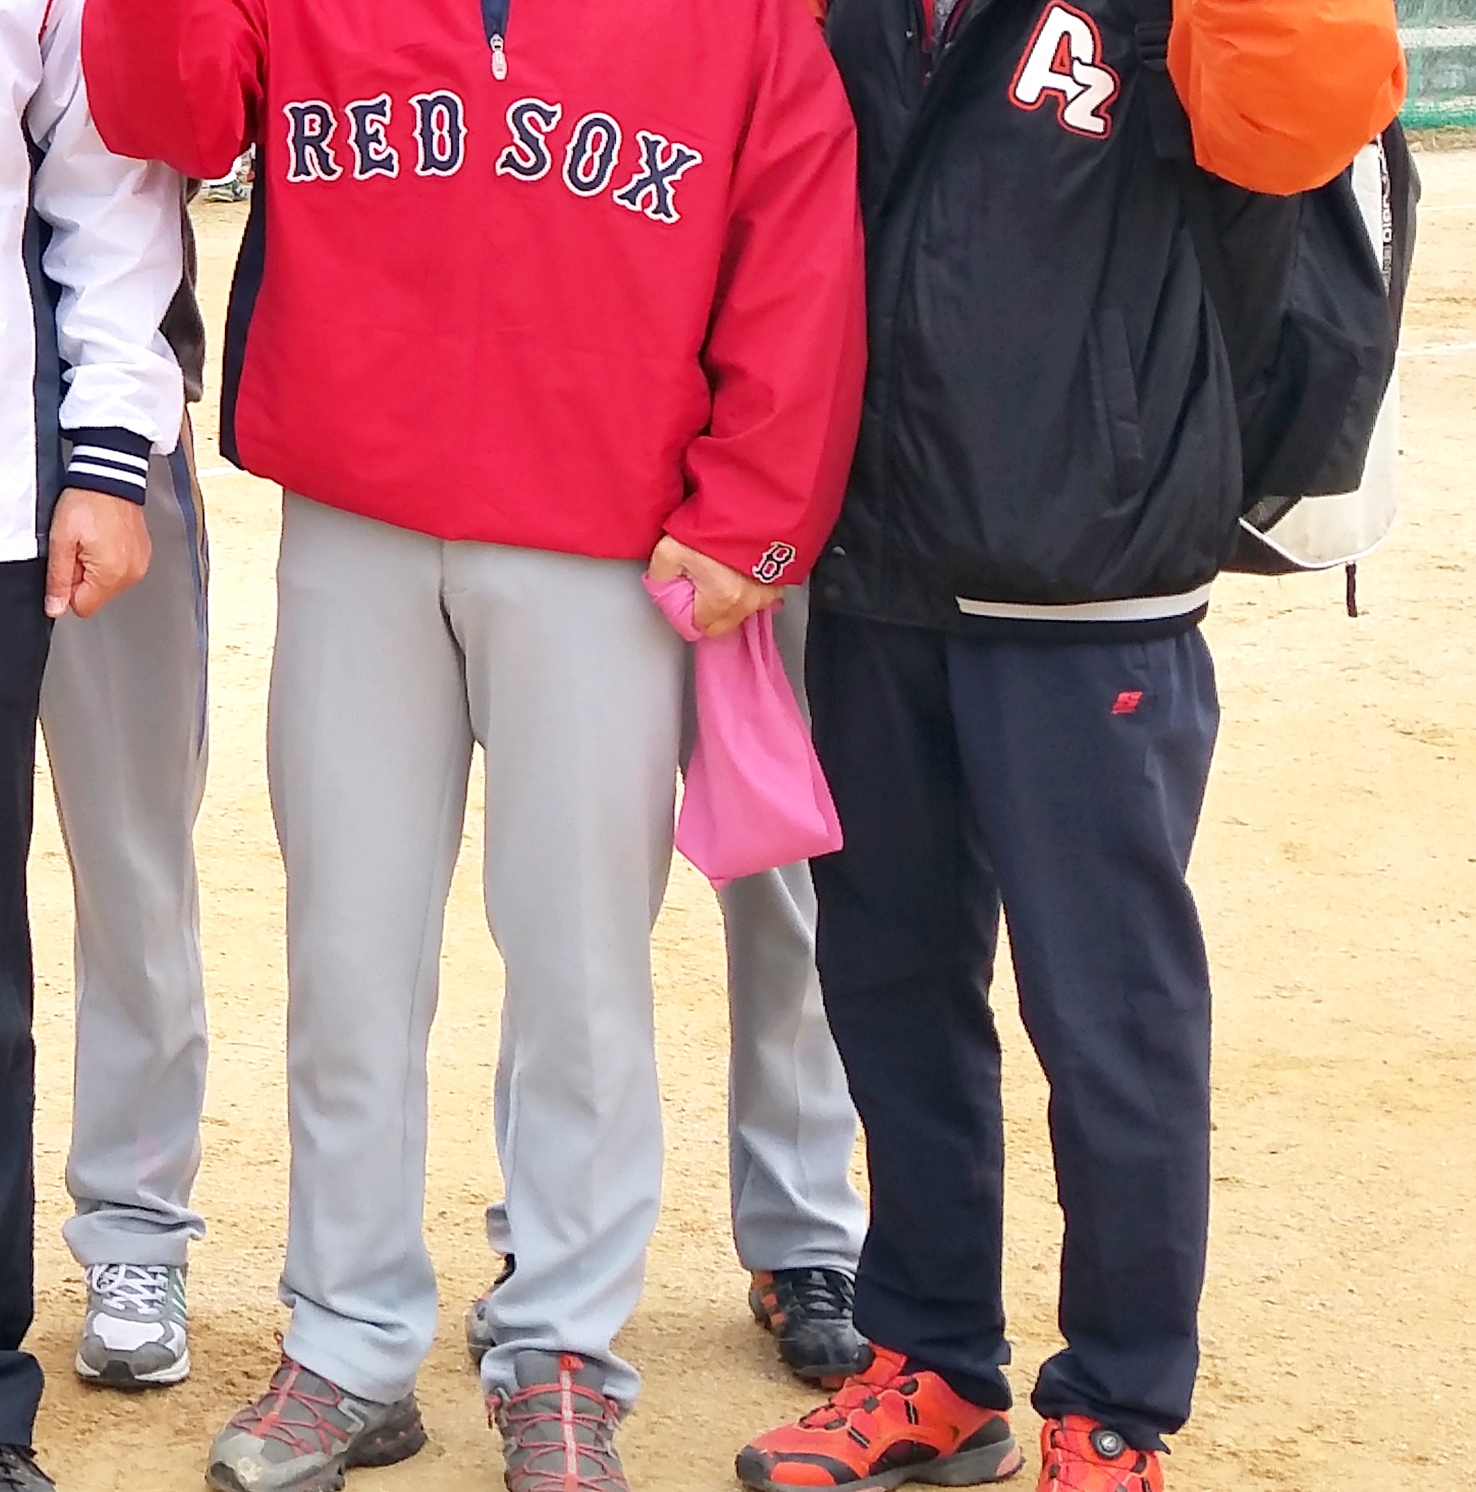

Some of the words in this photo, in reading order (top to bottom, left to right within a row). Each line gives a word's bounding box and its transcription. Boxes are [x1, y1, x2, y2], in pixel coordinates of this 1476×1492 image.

[284, 89, 468, 183] RED
[495, 97, 702, 224] SOX
[752, 541, 796, 583] B
